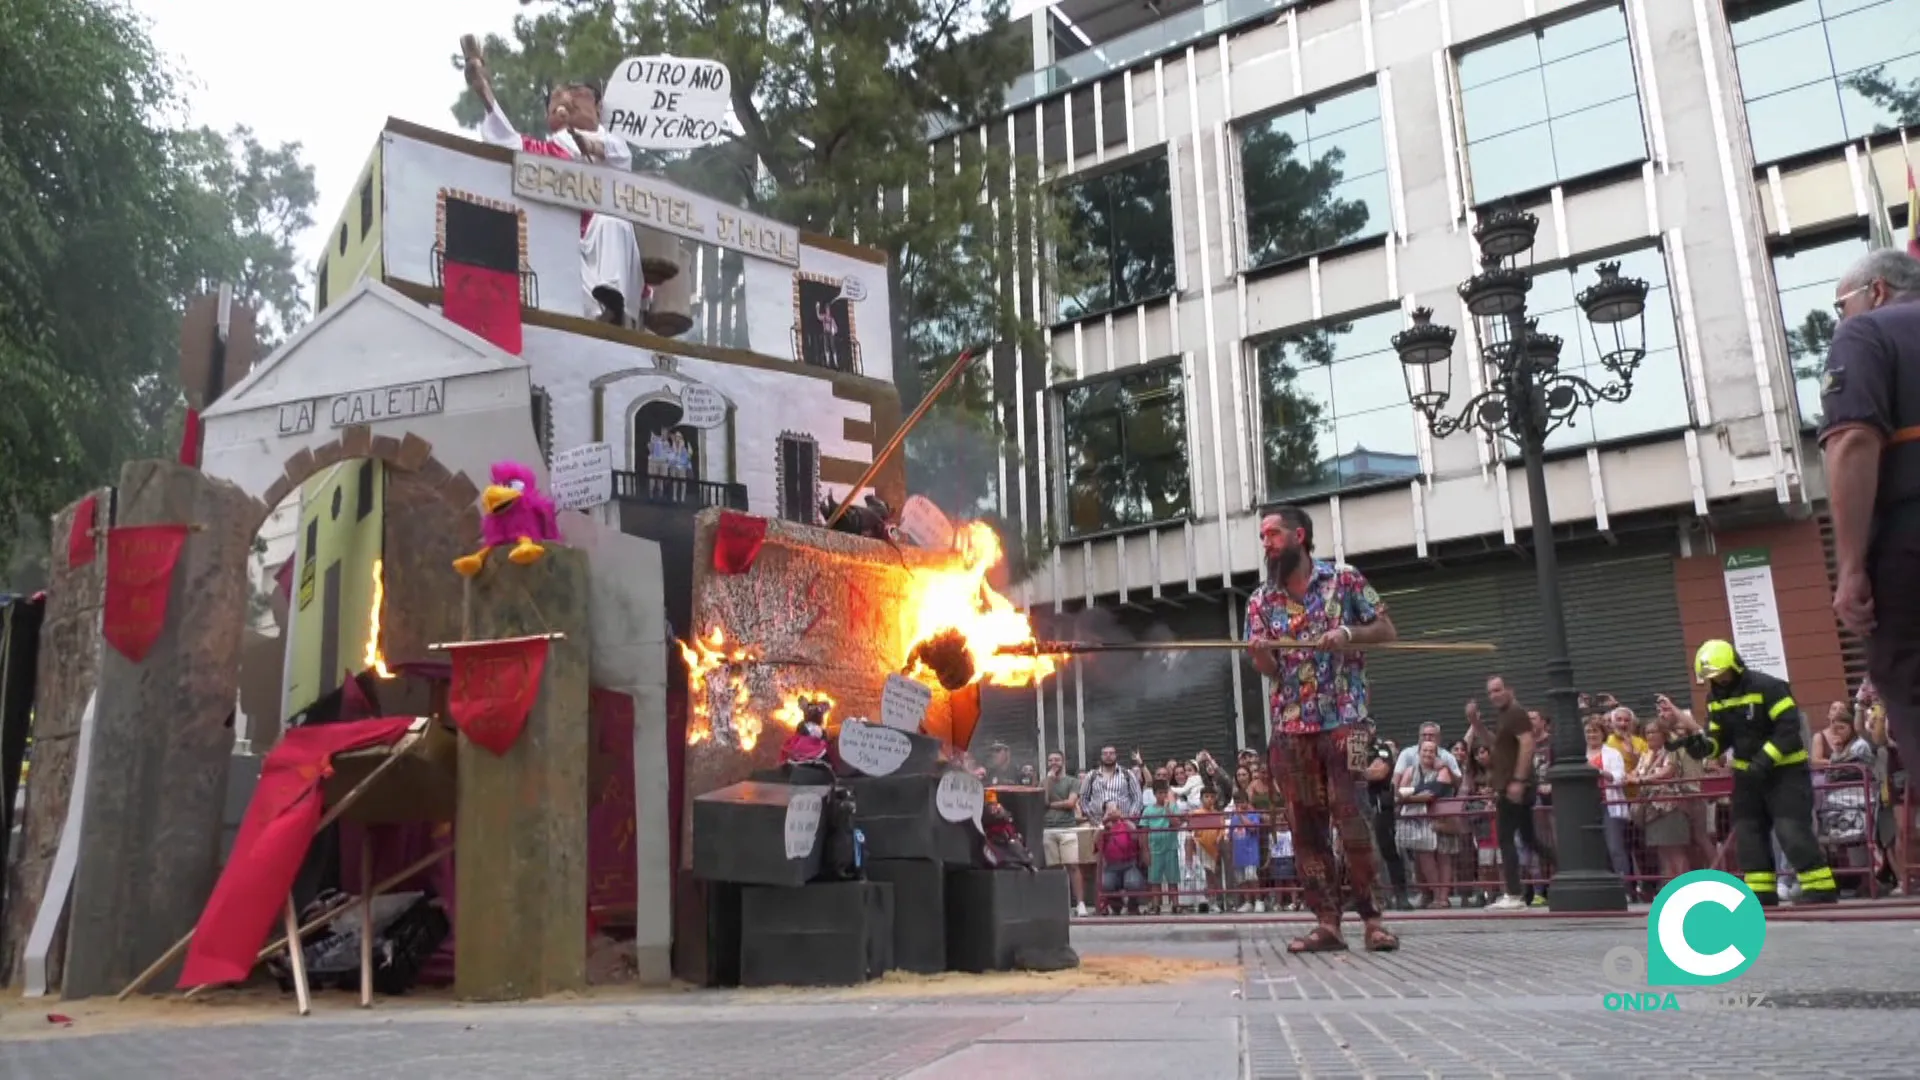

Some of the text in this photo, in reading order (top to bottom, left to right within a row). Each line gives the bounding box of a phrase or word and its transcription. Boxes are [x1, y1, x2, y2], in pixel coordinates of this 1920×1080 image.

[626, 61, 724, 91] OTRO AÑO
[651, 89, 682, 112] DE
[608, 109, 647, 138] PAN
[517, 162, 602, 205] GRAN
[612, 178, 705, 235] HOTEL
[279, 384, 441, 432] LA CALETA
